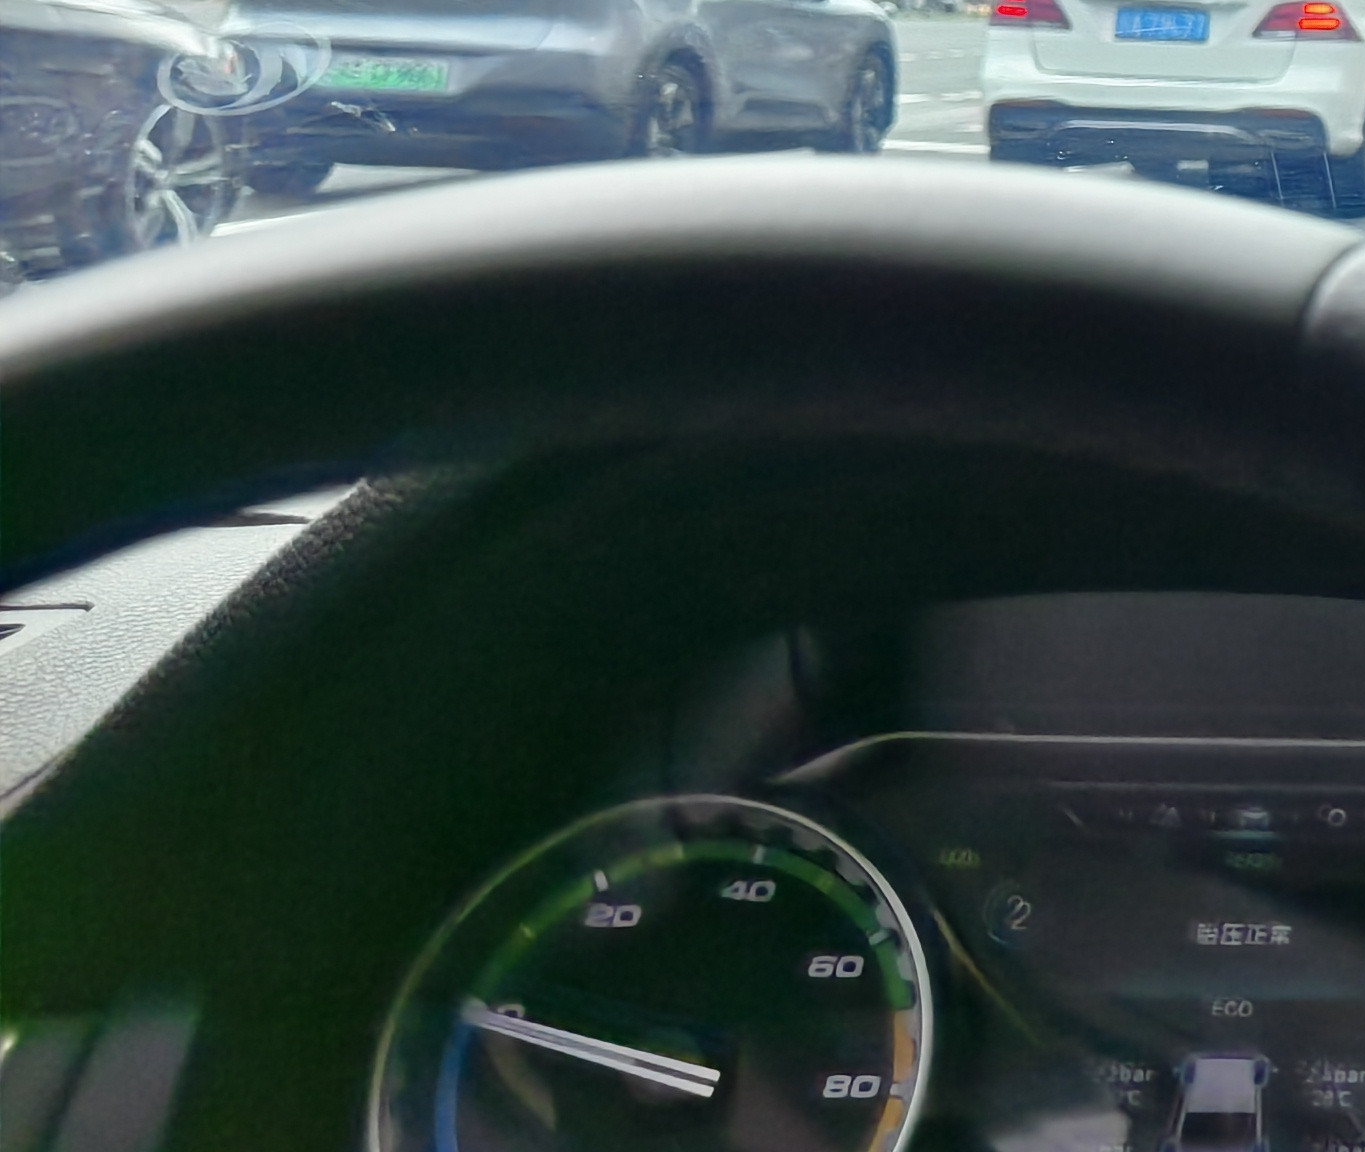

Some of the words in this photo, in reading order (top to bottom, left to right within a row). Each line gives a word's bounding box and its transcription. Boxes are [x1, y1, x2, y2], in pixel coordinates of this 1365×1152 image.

[720, 880, 776, 902] 40
[584, 904, 642, 928] 20
[808, 955, 864, 978] 60
[1211, 999, 1253, 1018] ECO
[822, 1074, 881, 1099] 80
